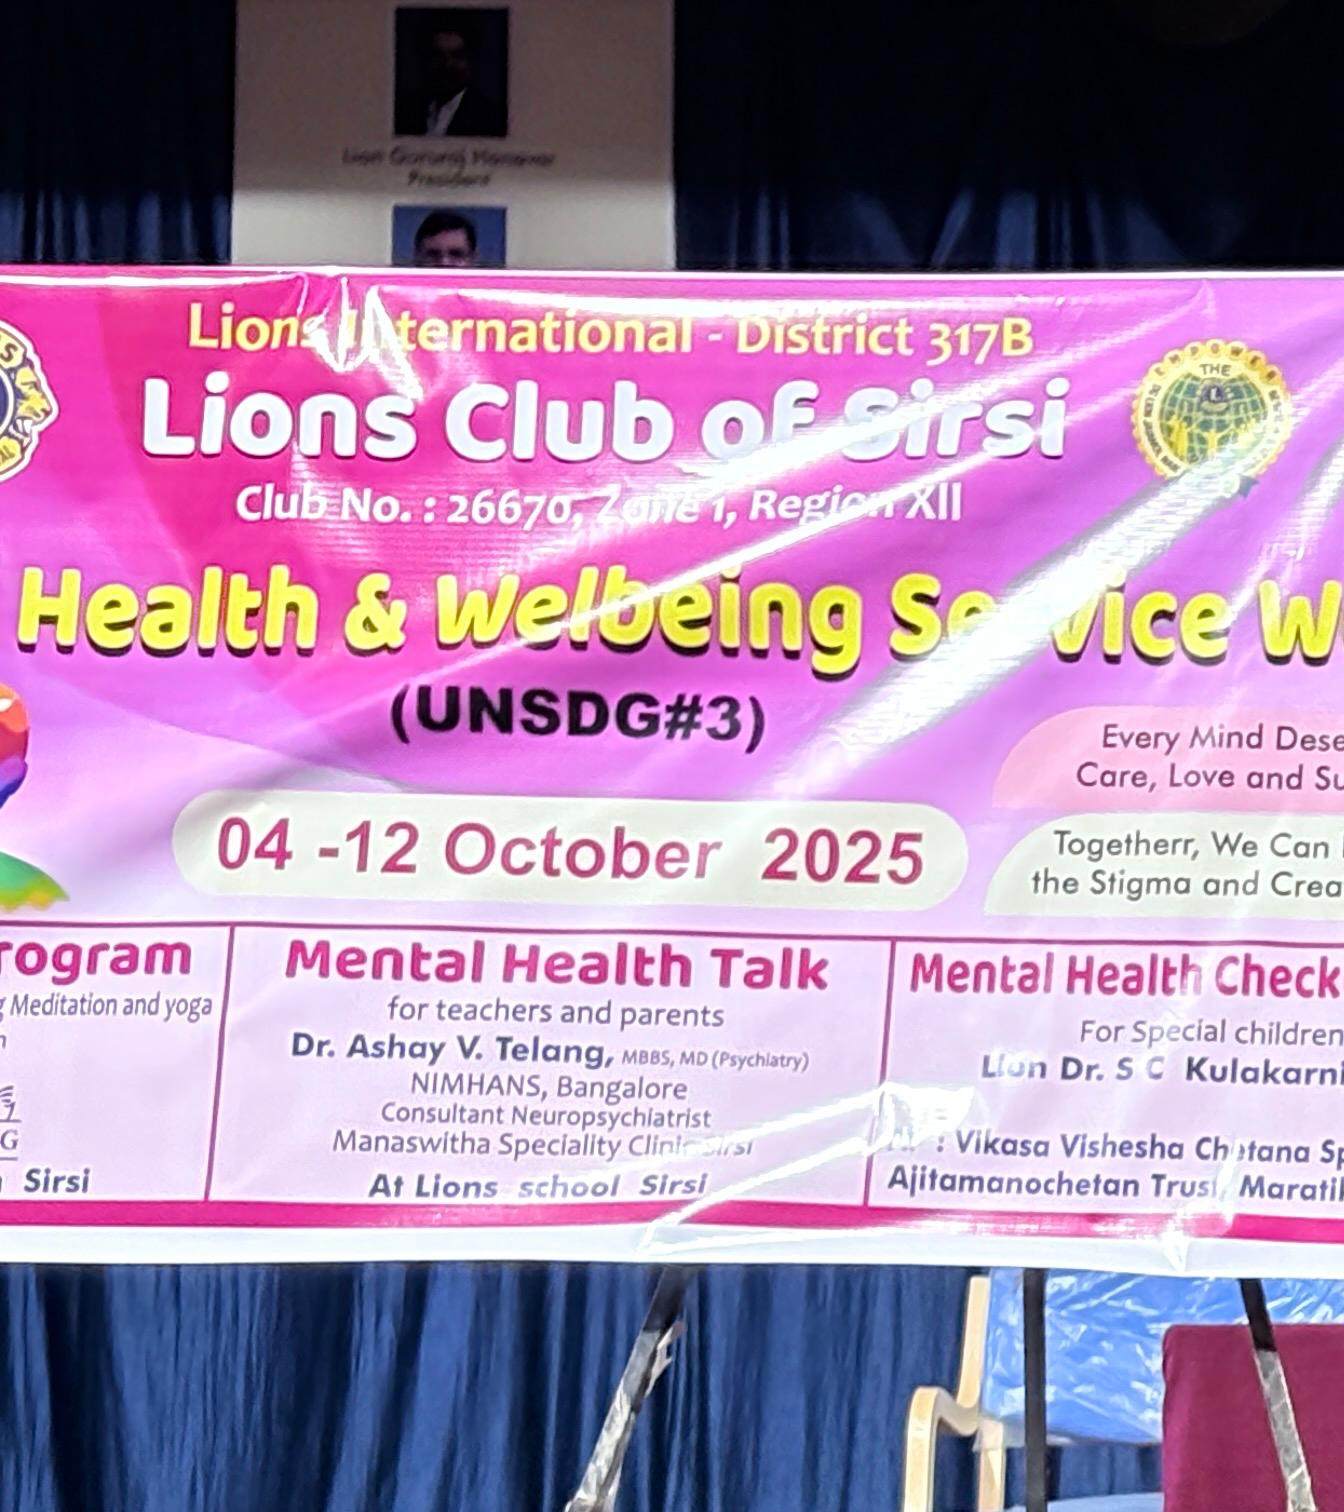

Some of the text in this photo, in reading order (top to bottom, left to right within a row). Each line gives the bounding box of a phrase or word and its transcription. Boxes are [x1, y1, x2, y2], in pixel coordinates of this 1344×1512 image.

[346, 308, 692, 354] Iternational
[737, 313, 914, 355] District
[925, 317, 1034, 366] 317B
[1199, 364, 1231, 376] THE
[142, 372, 417, 460] Lions
[445, 380, 675, 462] Club
[702, 379, 820, 461] of
[842, 377, 1070, 461] Sirsi
[236, 483, 327, 523] Club
[341, 487, 410, 523] No.
[447, 488, 584, 531] 26670,
[16, 566, 316, 654] Health
[343, 571, 407, 655] &
[435, 566, 864, 679] Welbeing
[888, 566, 1230, 664] Sevice
[390, 684, 765, 754] (UNSDG#3)
[1102, 724, 1180, 757] Every
[1189, 724, 1264, 752] Mind
[1076, 763, 1156, 793] Care,
[1168, 763, 1236, 790] Love
[1246, 763, 1304, 791] and
[217, 816, 924, 885] 04 -12 October 2025
[1053, 830, 1199, 862] Togetherr,
[1211, 832, 1262, 859] We
[1269, 833, 1330, 861] Can
[1031, 868, 1079, 897] the
[1090, 869, 1192, 902] Stigma
[1202, 869, 1260, 898] and
[285, 939, 829, 990] Mental Health Talk
[910, 950, 1053, 995] Mental
[1066, 954, 1200, 998] Health
[9, 992, 118, 1016] Meditation
[122, 991, 161, 1015] and
[164, 996, 214, 1023] yoga
[388, 996, 725, 1033] for teachers and parents
[1080, 1019, 1344, 1048] For Special children
[291, 1032, 810, 1073] Dr. Ashay V. Telang, MBBS, MD (Psychiatry)
[1060, 1056, 1105, 1081] Dr.
[1115, 1056, 1134, 1081] S
[1145, 1056, 1165, 1080] C
[410, 1072, 688, 1106] NIMHANS, Bangalore
[380, 1102, 712, 1131] Consultant Neuropsychiatrist
[332, 1130, 622, 1162] Manaswitha Speciality
[955, 1129, 1050, 1158] Vikasa
[1059, 1132, 1185, 1160] Vishesha
[23, 1167, 91, 1194] Sirsi
[414, 1171, 708, 1199] Lions school Sirsi
[887, 1164, 1140, 1197] Ajitamanochetan
